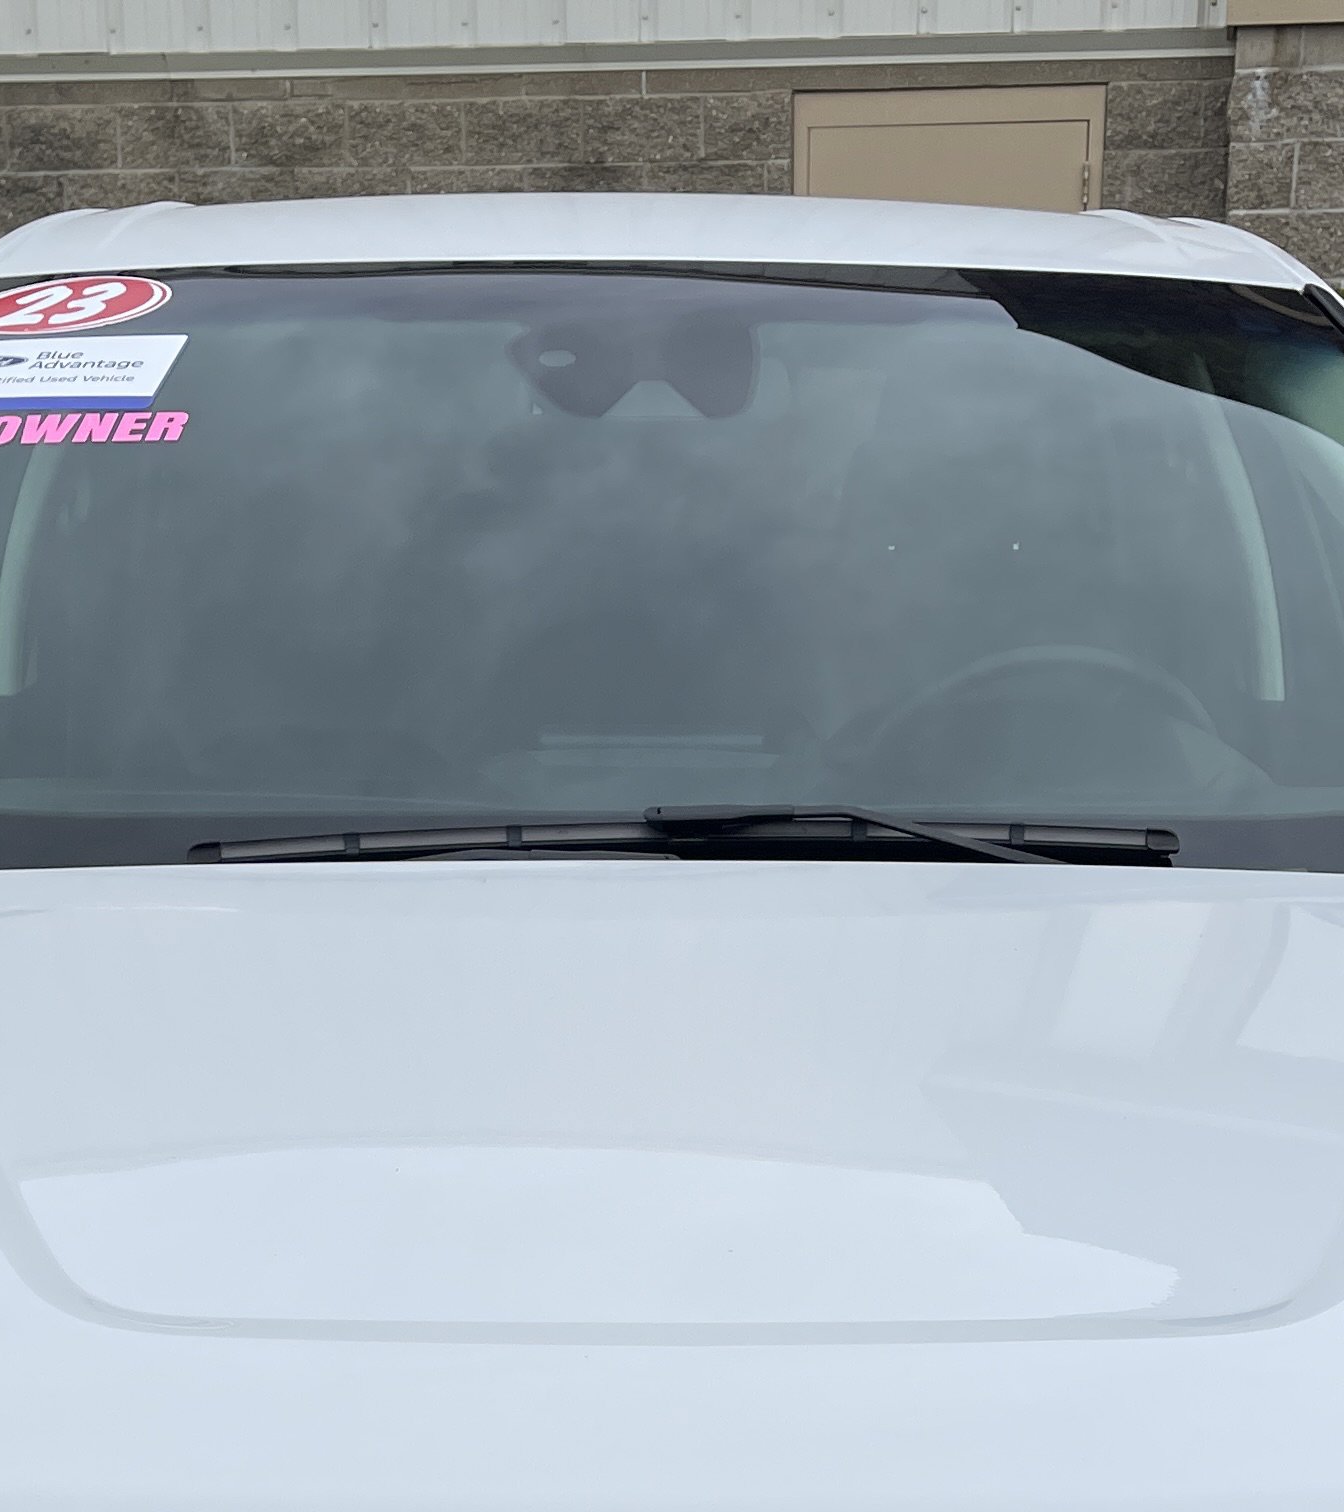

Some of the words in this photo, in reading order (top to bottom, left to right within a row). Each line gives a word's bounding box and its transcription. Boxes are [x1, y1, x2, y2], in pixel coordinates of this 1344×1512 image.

[36, 351, 84, 360] Blue
[28, 359, 145, 370] Advantage
[39, 375, 78, 384] Used
[83, 374, 135, 383] Vehicle
